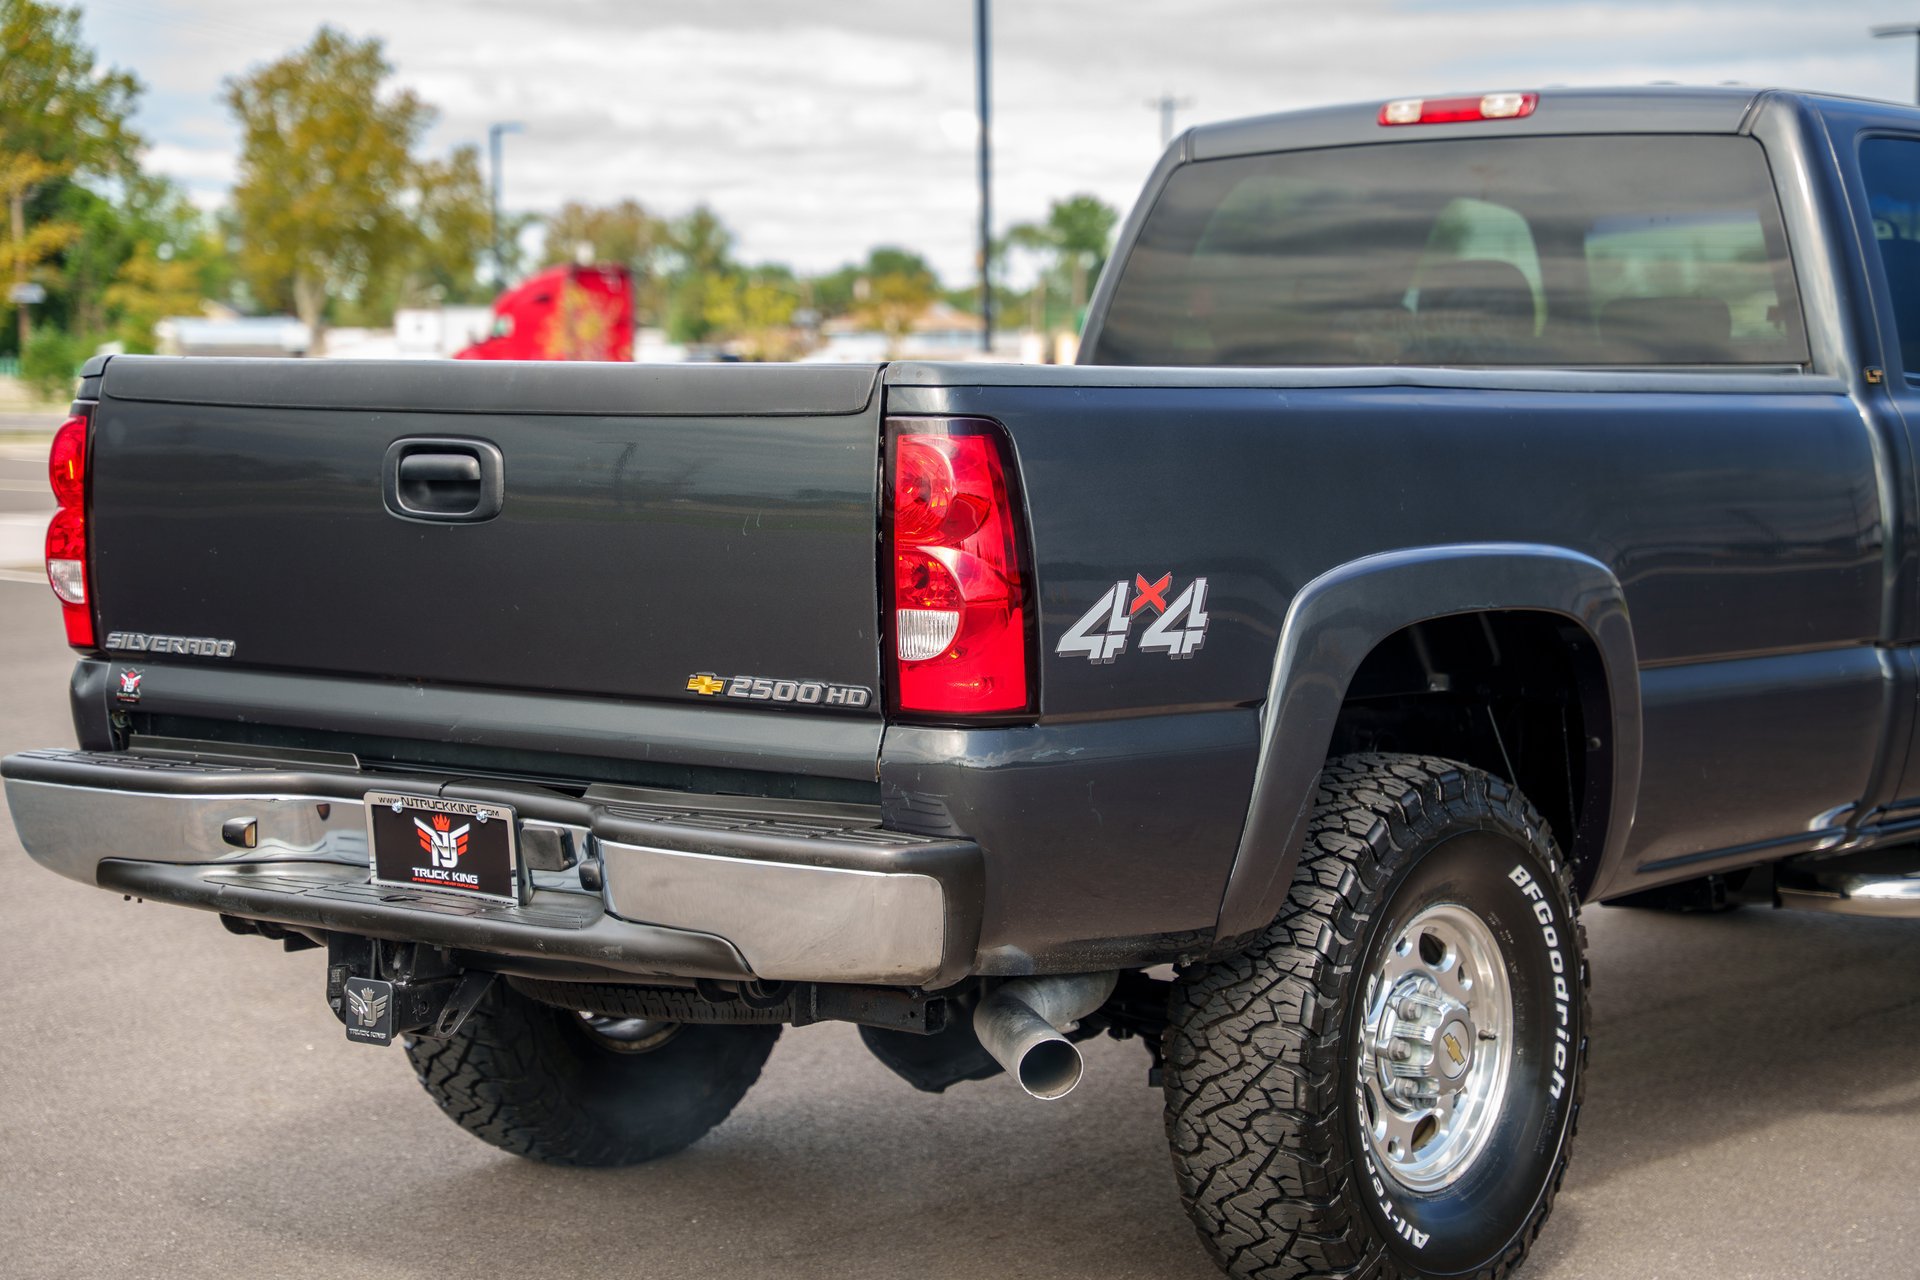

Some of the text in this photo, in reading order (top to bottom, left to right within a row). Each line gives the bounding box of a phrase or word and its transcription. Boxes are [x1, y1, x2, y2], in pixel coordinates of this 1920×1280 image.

[105, 631, 236, 658] SILVERADO
[726, 676, 870, 706] 2500 HD
[412, 867, 450, 881] TRUCK
[452, 871, 479, 885] KING
[1508, 864, 1570, 1100] BFGoodrich
